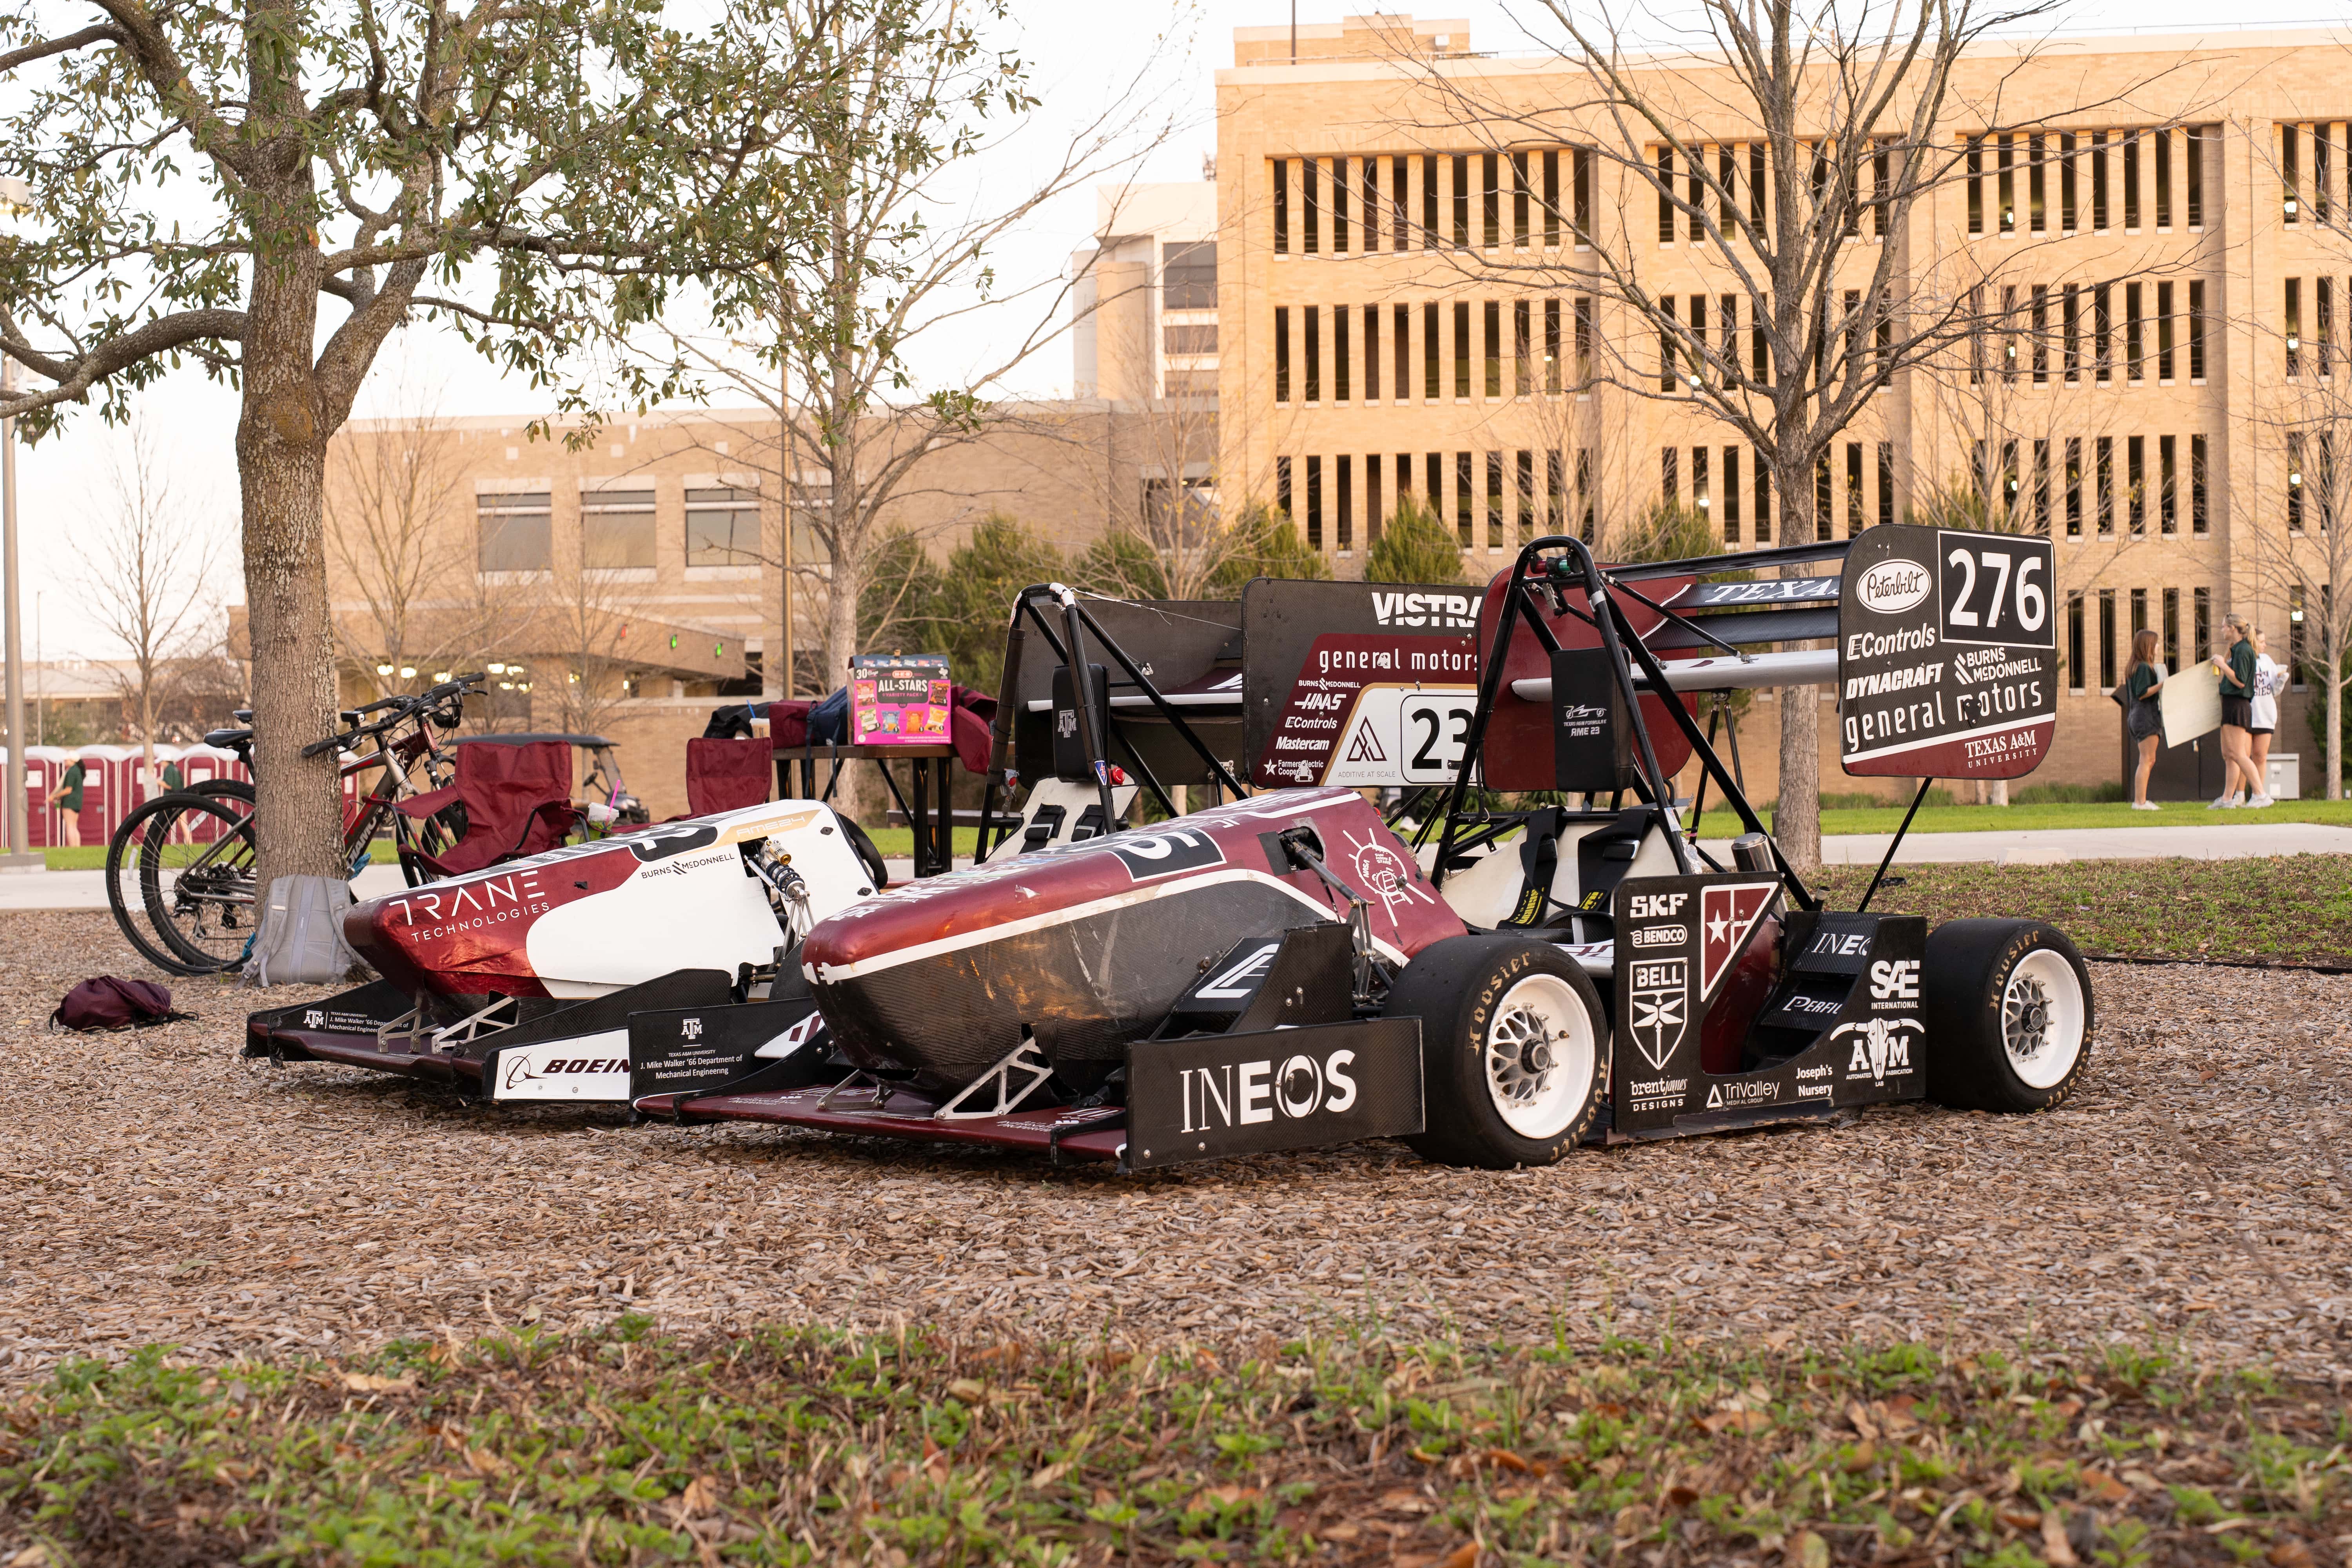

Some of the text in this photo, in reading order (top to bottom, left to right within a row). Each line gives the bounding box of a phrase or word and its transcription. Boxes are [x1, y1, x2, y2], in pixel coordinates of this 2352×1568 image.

[1704, 579, 1840, 603] TEXA
[1866, 570, 1924, 601] Peterbilt
[1949, 549, 2045, 631] 276
[1847, 623, 1935, 661] EControls
[1967, 647, 2006, 667] BURNS
[856, 668, 867, 679] 30
[1846, 663, 1944, 700] DYNACRAFT
[878, 680, 927, 693] ALL-STARS
[1294, 693, 1347, 710] HAAS
[1285, 717, 1338, 729] EControls
[1570, 726, 1600, 737] AME 23
[1846, 691, 1945, 752] general
[1276, 736, 1330, 750] Mastercam
[1965, 730, 2036, 758] TEXAS A&M
[1278, 759, 1301, 768] Farmers
[1968, 748, 2038, 769] UNIVERSITY
[737, 816, 806, 838] AME24
[641, 867, 671, 878] BURNS
[389, 870, 545, 926] TRANE
[1630, 893, 1688, 918] SKF
[411, 902, 549, 943] TECHNOLOGIES
[1644, 928, 1685, 944] BENDCO
[1637, 965, 1682, 987] BELL
[1870, 960, 1920, 999] SAE
[1468, 951, 1530, 1056] Hoosier
[1871, 1001, 1918, 1010] INTERNATIONAL
[698, 1056, 734, 1065] Department
[656, 1068, 728, 1079] Mechanical Engineering
[1796, 1064, 1833, 1080] Joseph's
[1180, 1049, 1357, 1133] INEOS
[1724, 1081, 1780, 1100] TriValley
[1798, 1085, 1833, 1097] Nursery
[1633, 1098, 1684, 1112] DESIGNS
